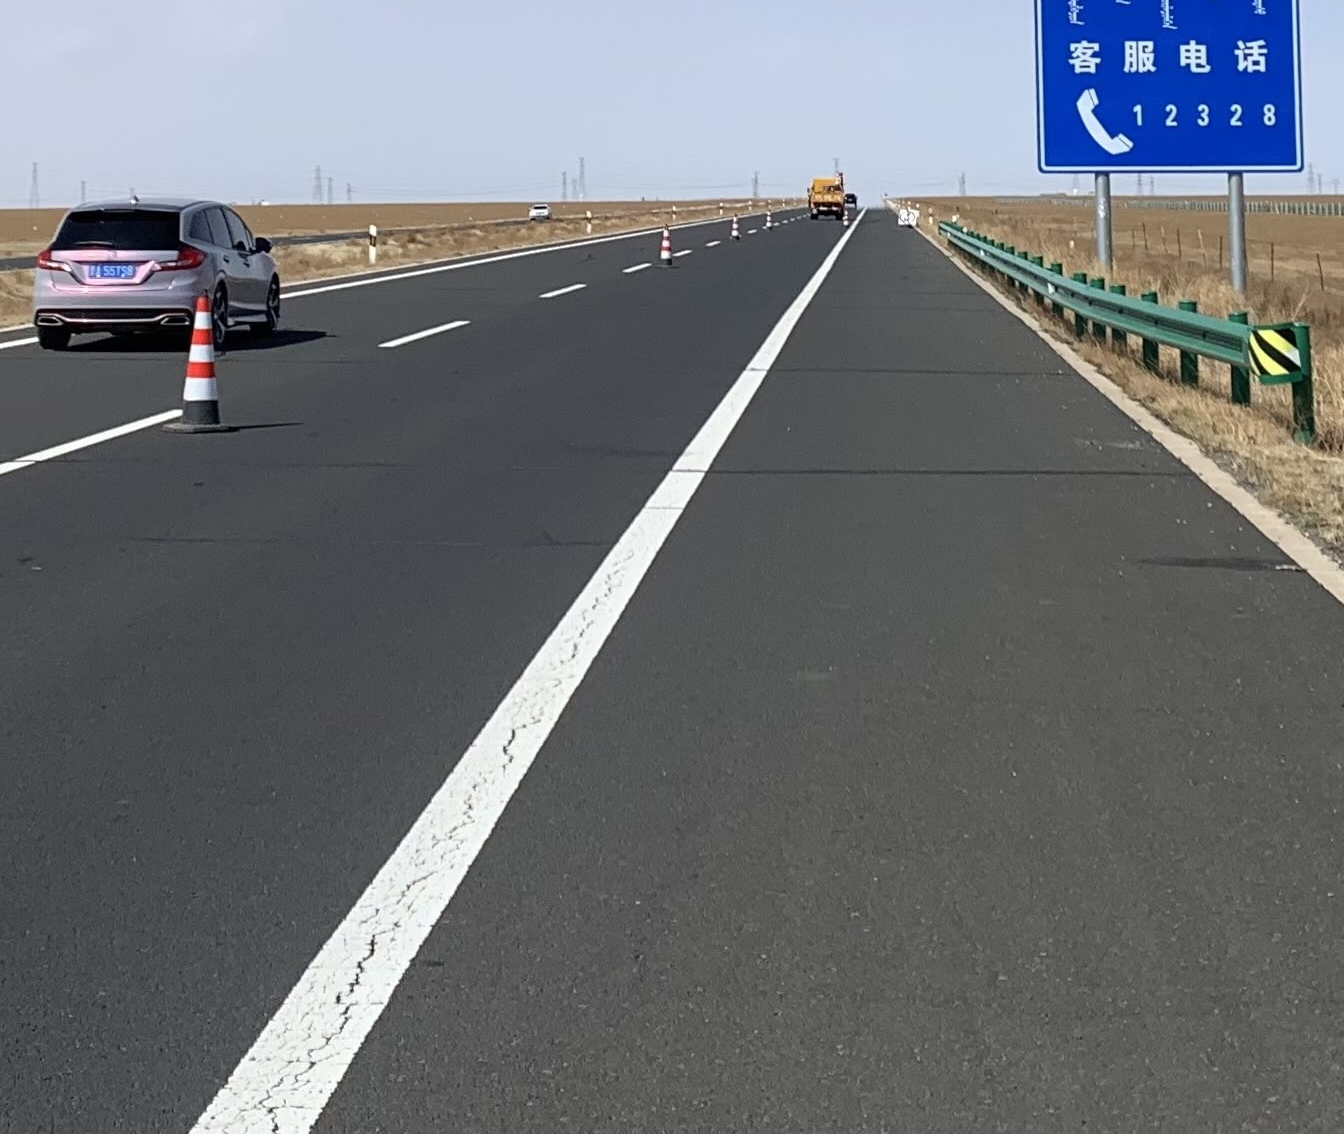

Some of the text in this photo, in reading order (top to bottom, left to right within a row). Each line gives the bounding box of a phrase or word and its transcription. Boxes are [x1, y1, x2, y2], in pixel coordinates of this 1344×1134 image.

[1068, 40, 1268, 73] 客服电话
[1133, 104, 1276, 127] 12328
